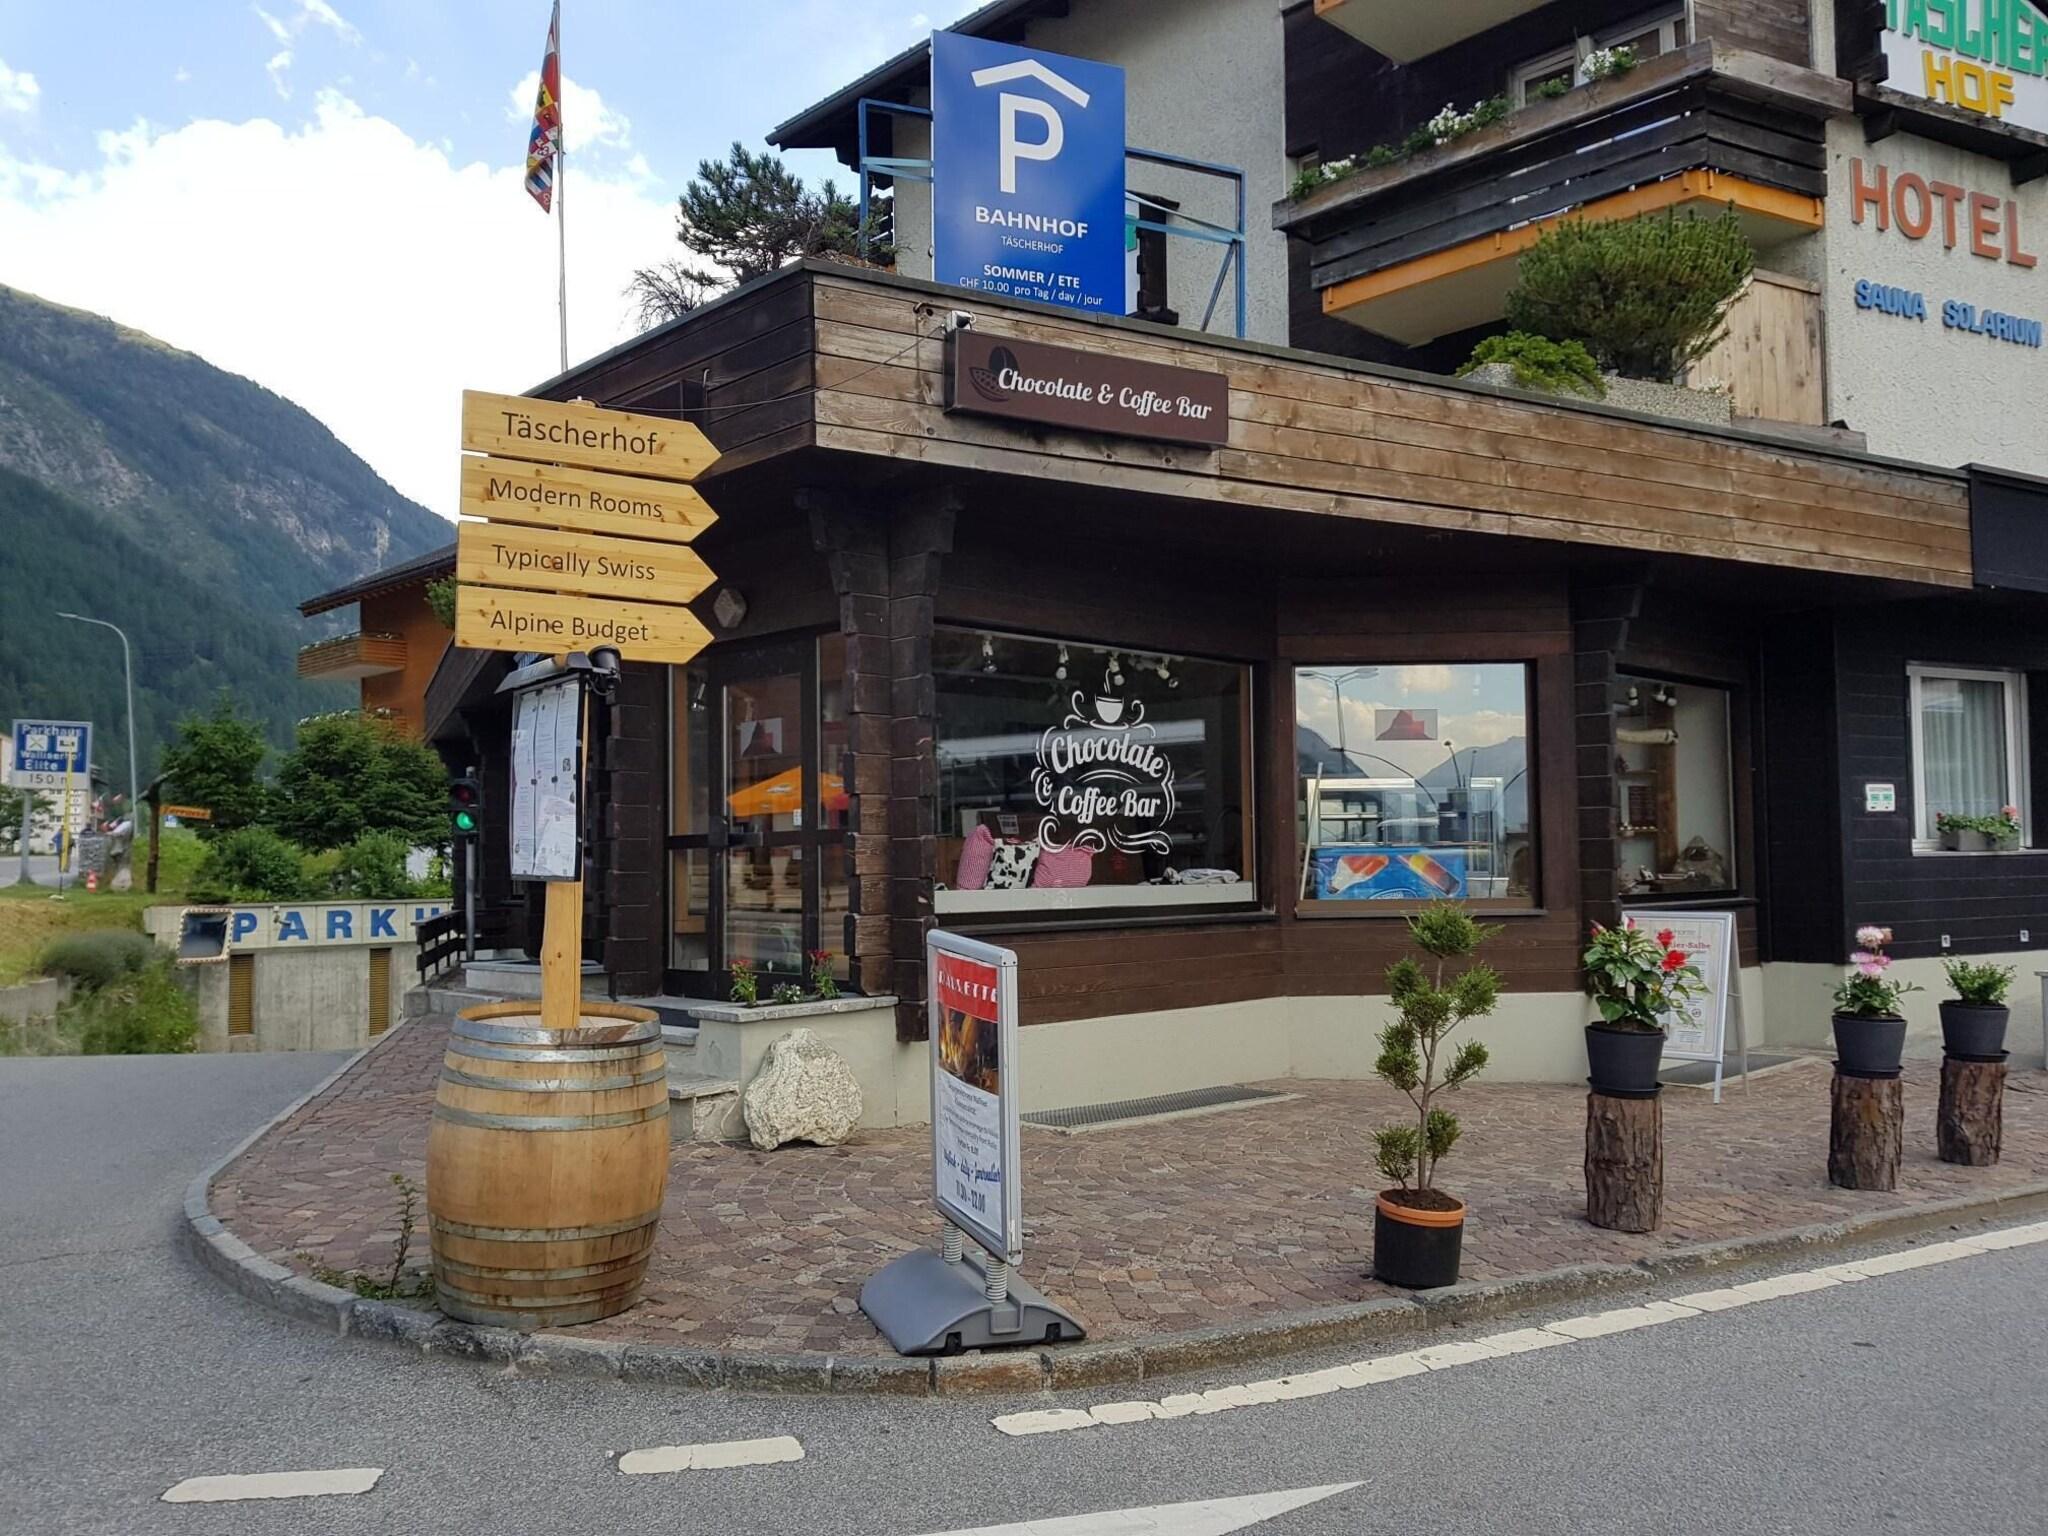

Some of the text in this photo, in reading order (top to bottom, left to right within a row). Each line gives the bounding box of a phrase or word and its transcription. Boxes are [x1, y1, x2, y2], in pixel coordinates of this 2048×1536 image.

[1921, 49, 2016, 119] HOF
[1000, 92, 1064, 194] P
[975, 206, 1089, 239] BAHNHOF
[1850, 157, 2038, 269] HOTEL
[959, 276, 979, 289] CHF
[982, 279, 1010, 293] 10.00
[1014, 285, 1031, 297] pro
[1033, 286, 1049, 301] Tag
[1058, 290, 1075, 304] day
[1083, 293, 1103, 306] jour
[983, 264, 1081, 289] SOMMER / ETE
[1855, 278, 2044, 349] SAUNA SOLARIUM
[997, 366, 1212, 420] Chocolate & Coffee Bar
[501, 411, 658, 456] Täscherhof
[489, 477, 663, 519] Modern Rooms
[492, 544, 656, 581] Typically Swiss
[490, 609, 649, 643] Alpine Budget
[24, 759, 58, 771] Elite
[1051, 733, 1165, 778] Chocolate
[29, 773, 54, 785] 150
[1042, 776, 1161, 824] & Coffee Bar
